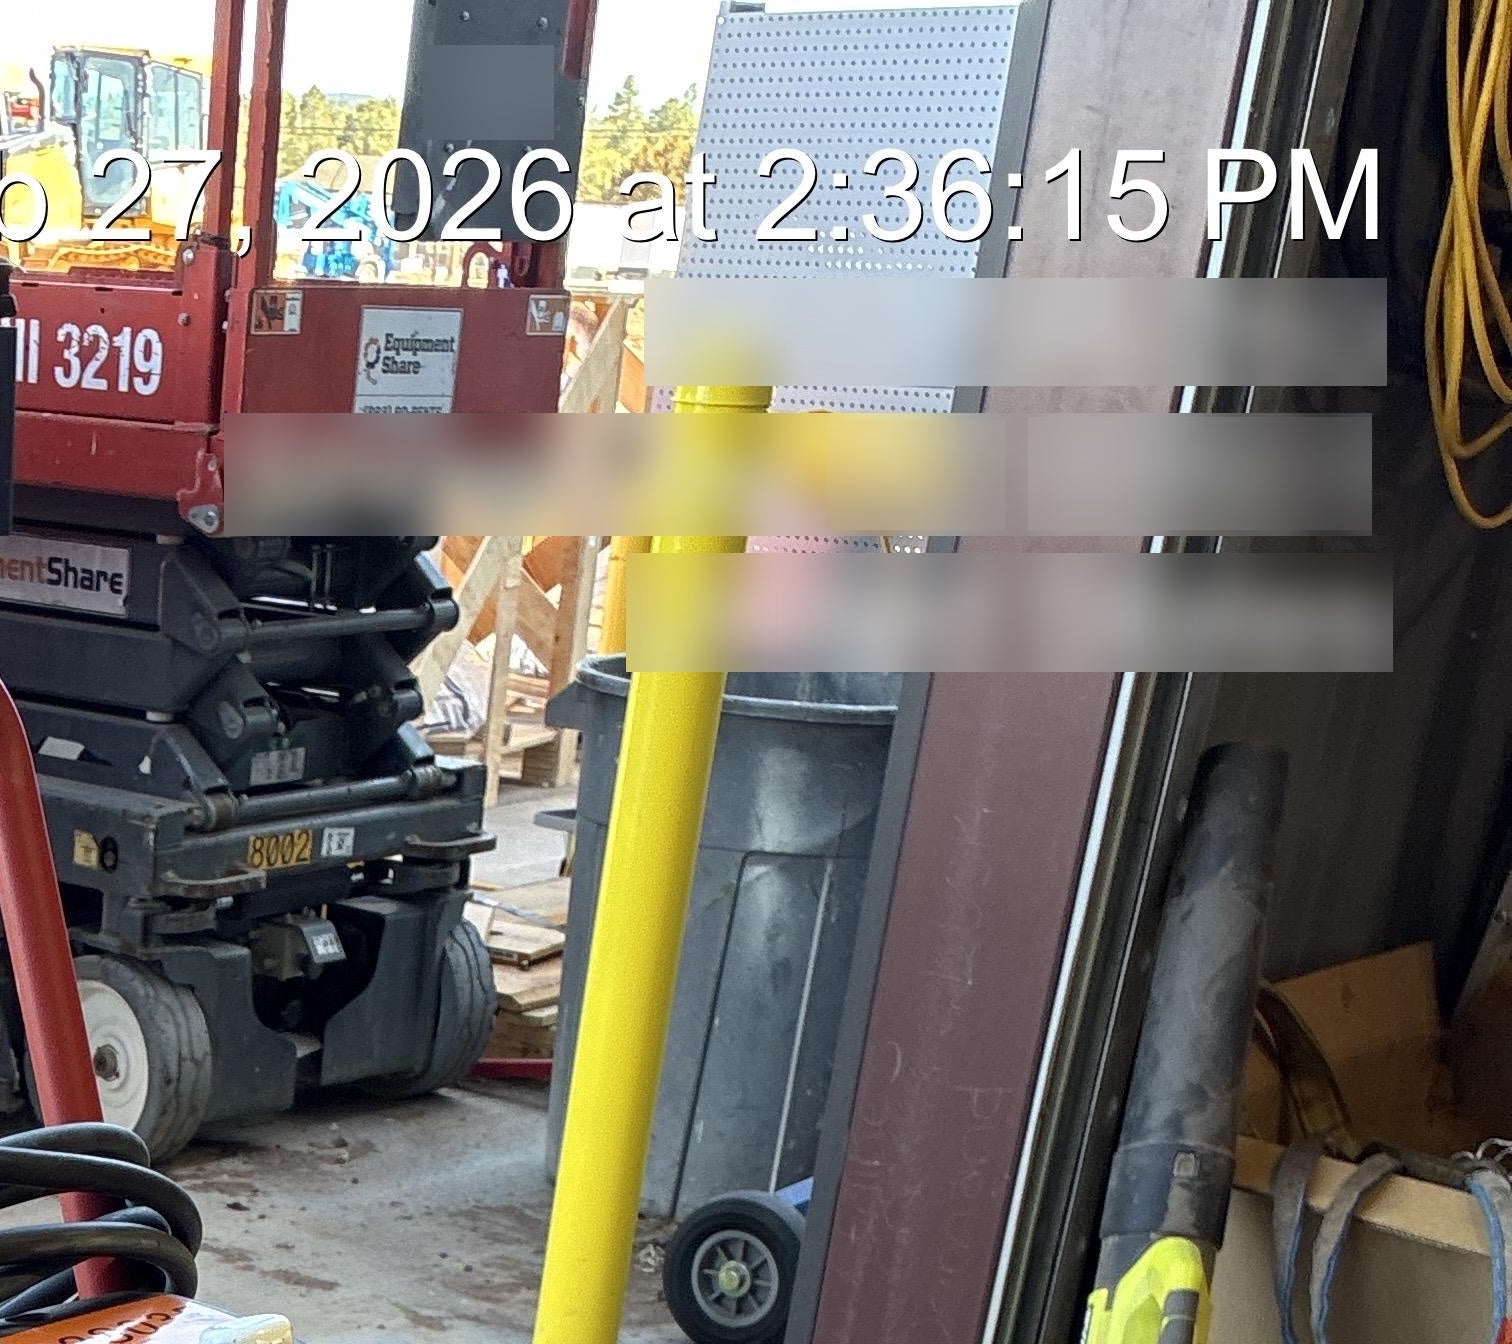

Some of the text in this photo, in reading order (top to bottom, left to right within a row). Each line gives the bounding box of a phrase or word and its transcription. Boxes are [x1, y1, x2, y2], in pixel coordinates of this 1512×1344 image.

[53, 322, 163, 396] 3219
[384, 332, 456, 356] Equipment
[381, 355, 421, 375] Share
[250, 830, 311, 868] 8002
